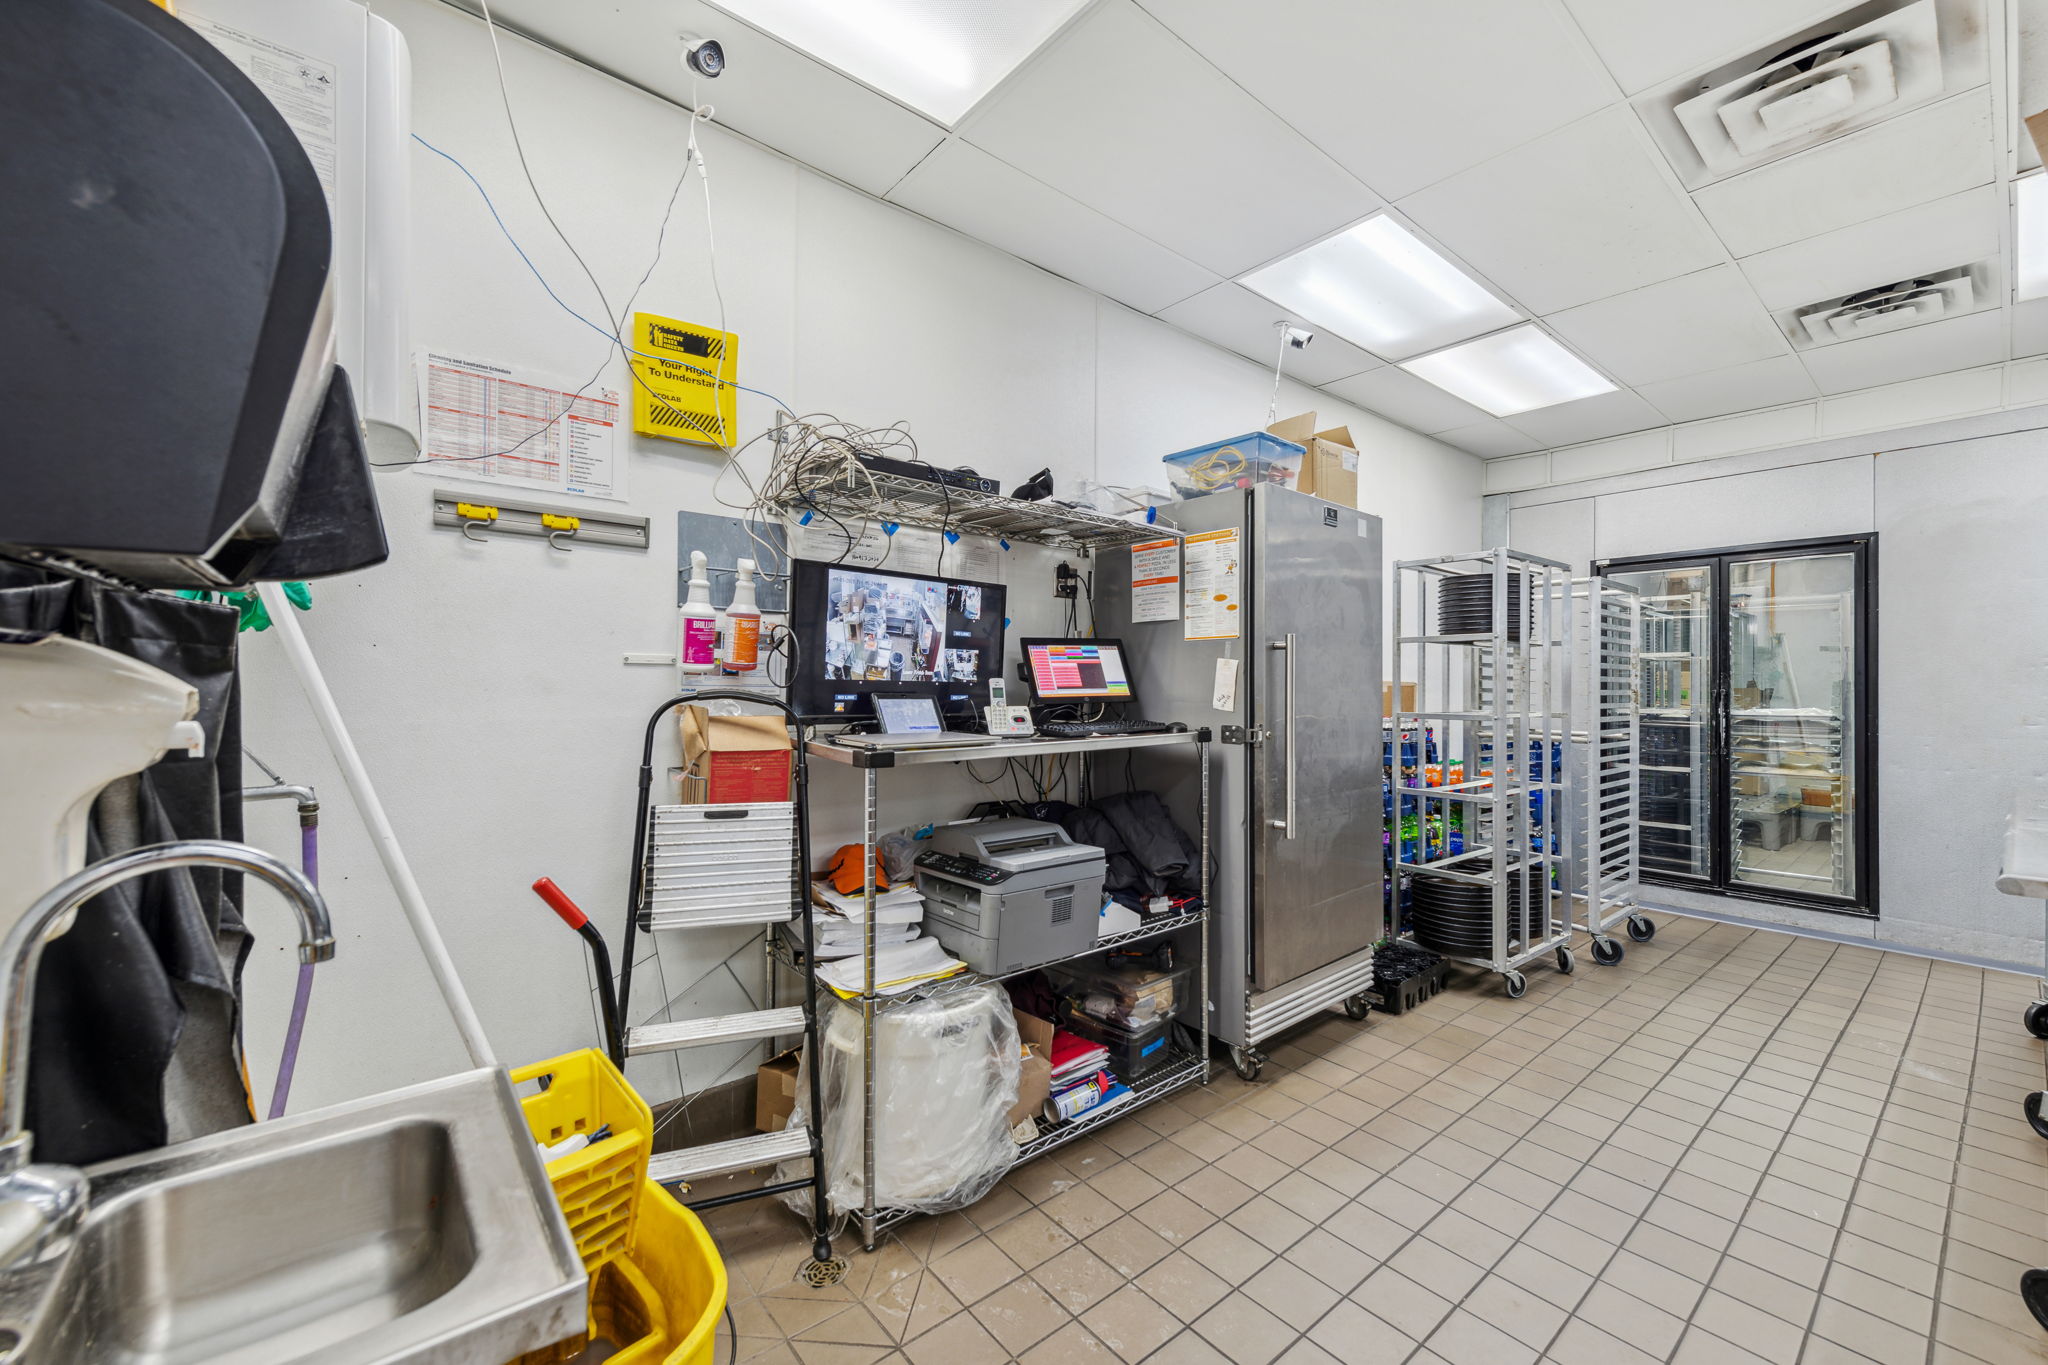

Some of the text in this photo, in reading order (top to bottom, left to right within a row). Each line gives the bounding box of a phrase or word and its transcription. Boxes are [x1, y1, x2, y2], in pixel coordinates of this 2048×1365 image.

[463, 360, 488, 370] Sanitation
[489, 366, 512, 375] Schedule
[659, 359, 712, 376] Your Right
[648, 366, 724, 390] To Understand
[652, 392, 682, 403] OLAB
